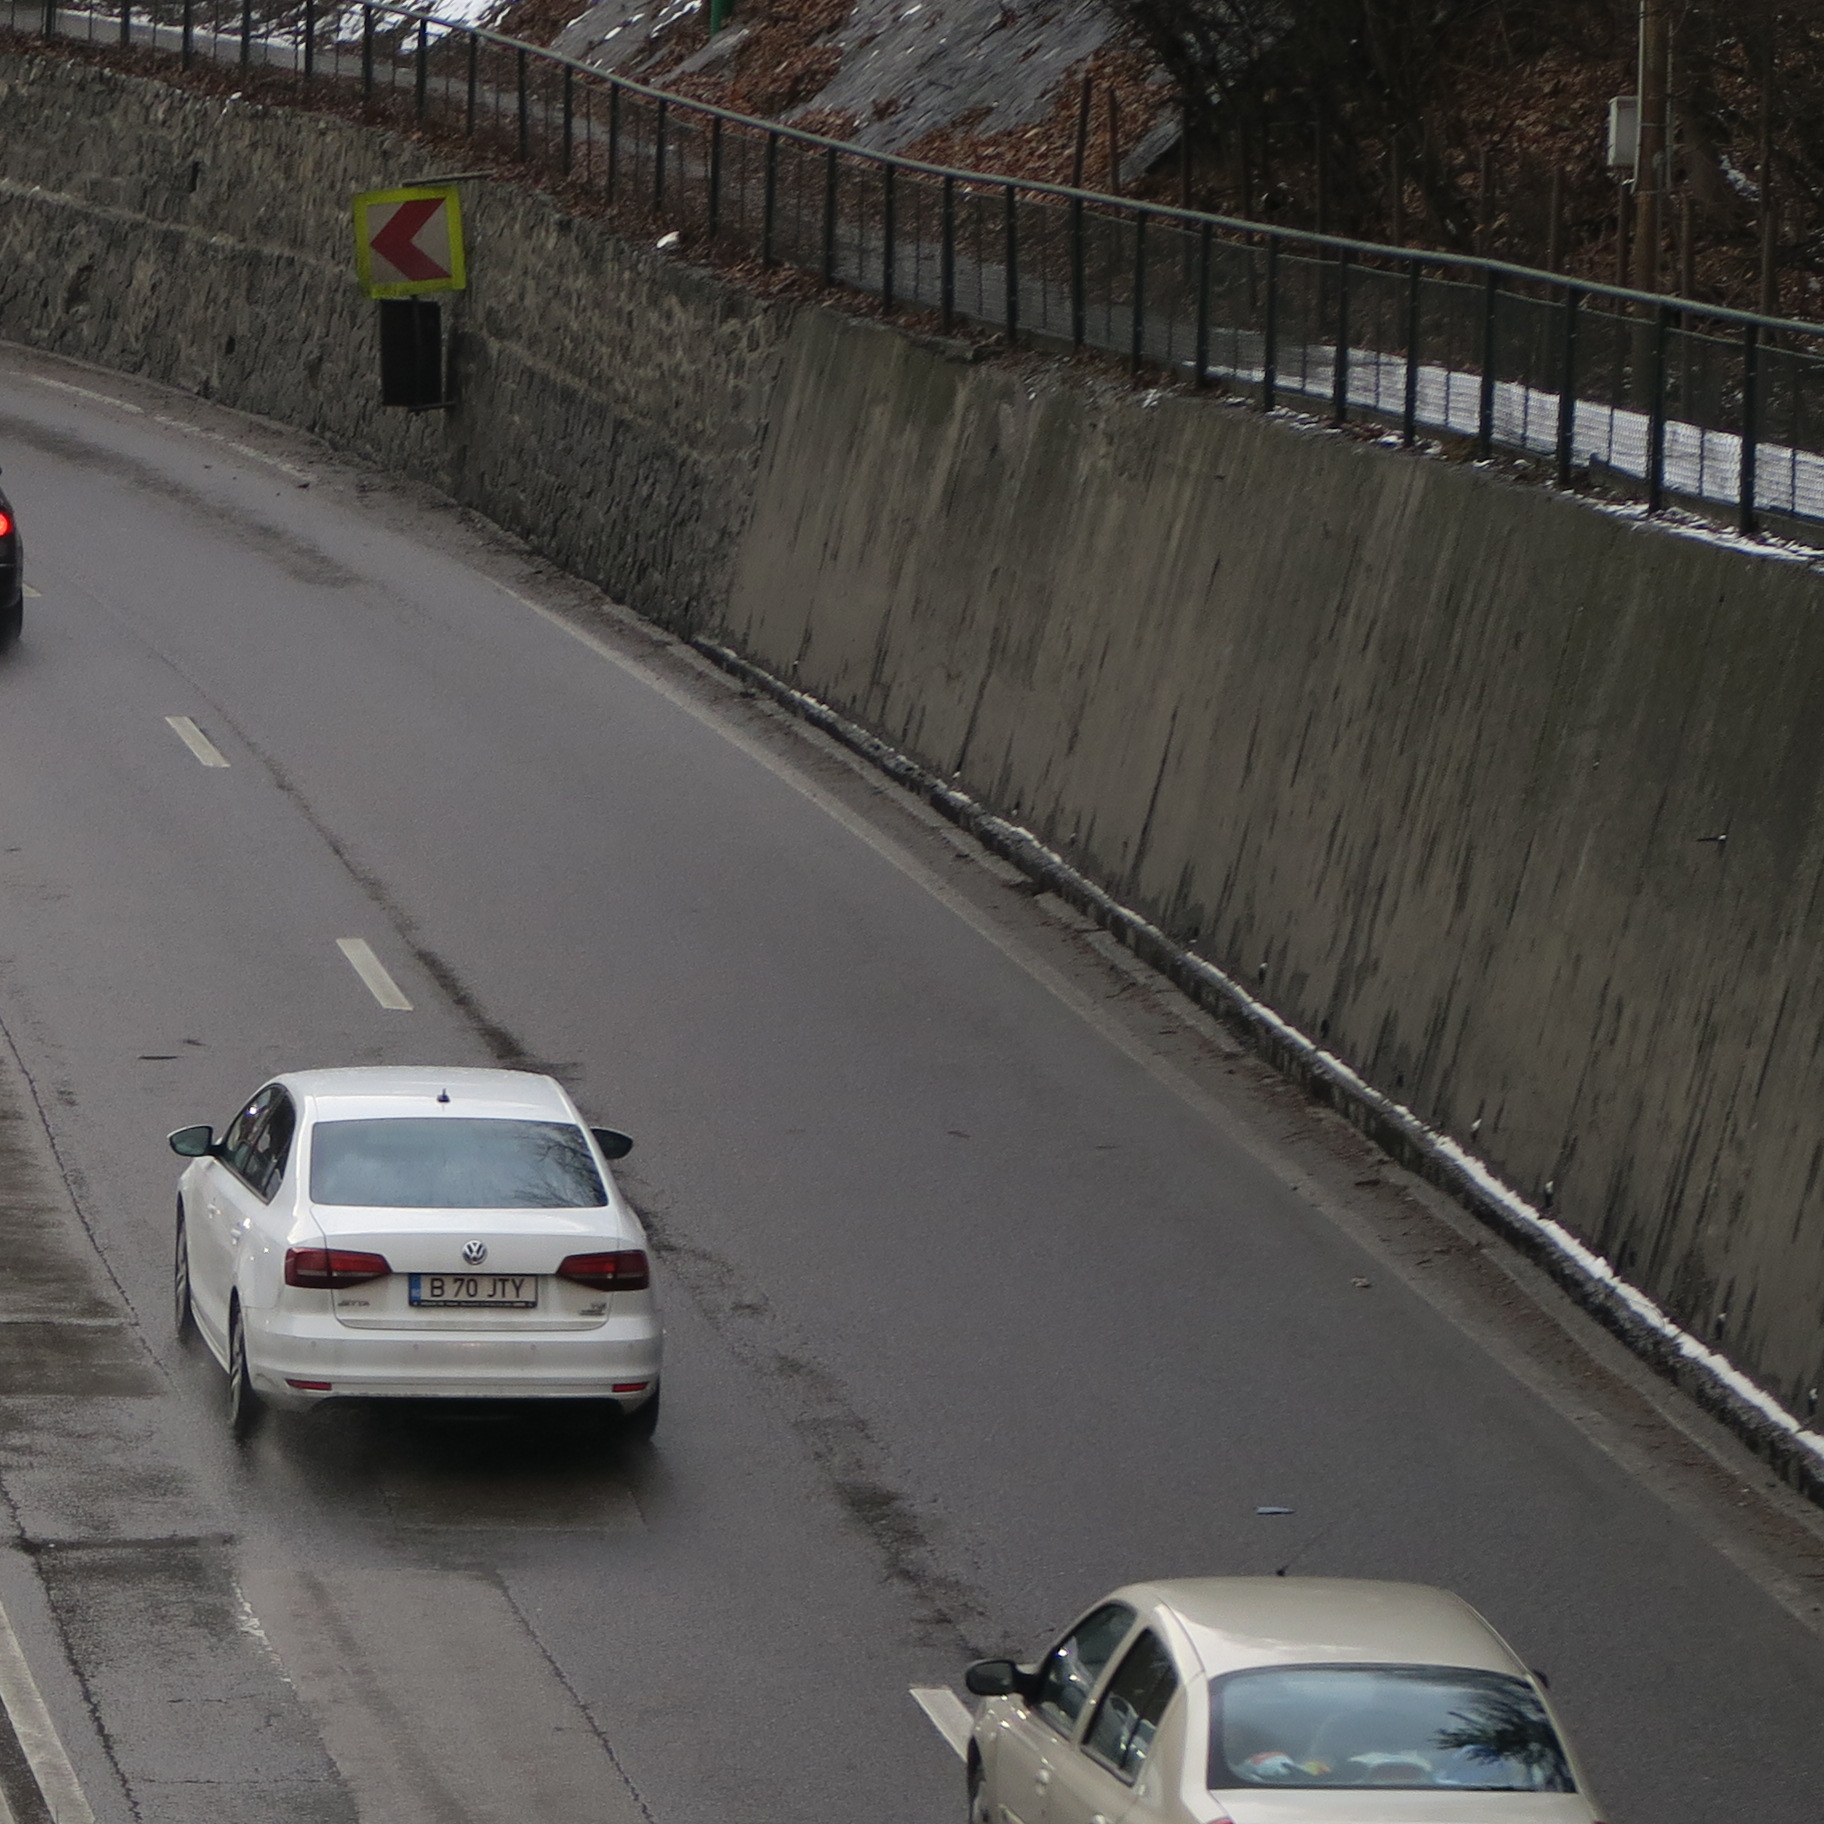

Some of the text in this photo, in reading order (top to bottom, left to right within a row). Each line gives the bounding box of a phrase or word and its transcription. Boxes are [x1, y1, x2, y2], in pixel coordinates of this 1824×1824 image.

[431, 1277, 445, 1298] B
[453, 1277, 478, 1298] 70
[487, 1277, 525, 1298] JTY
